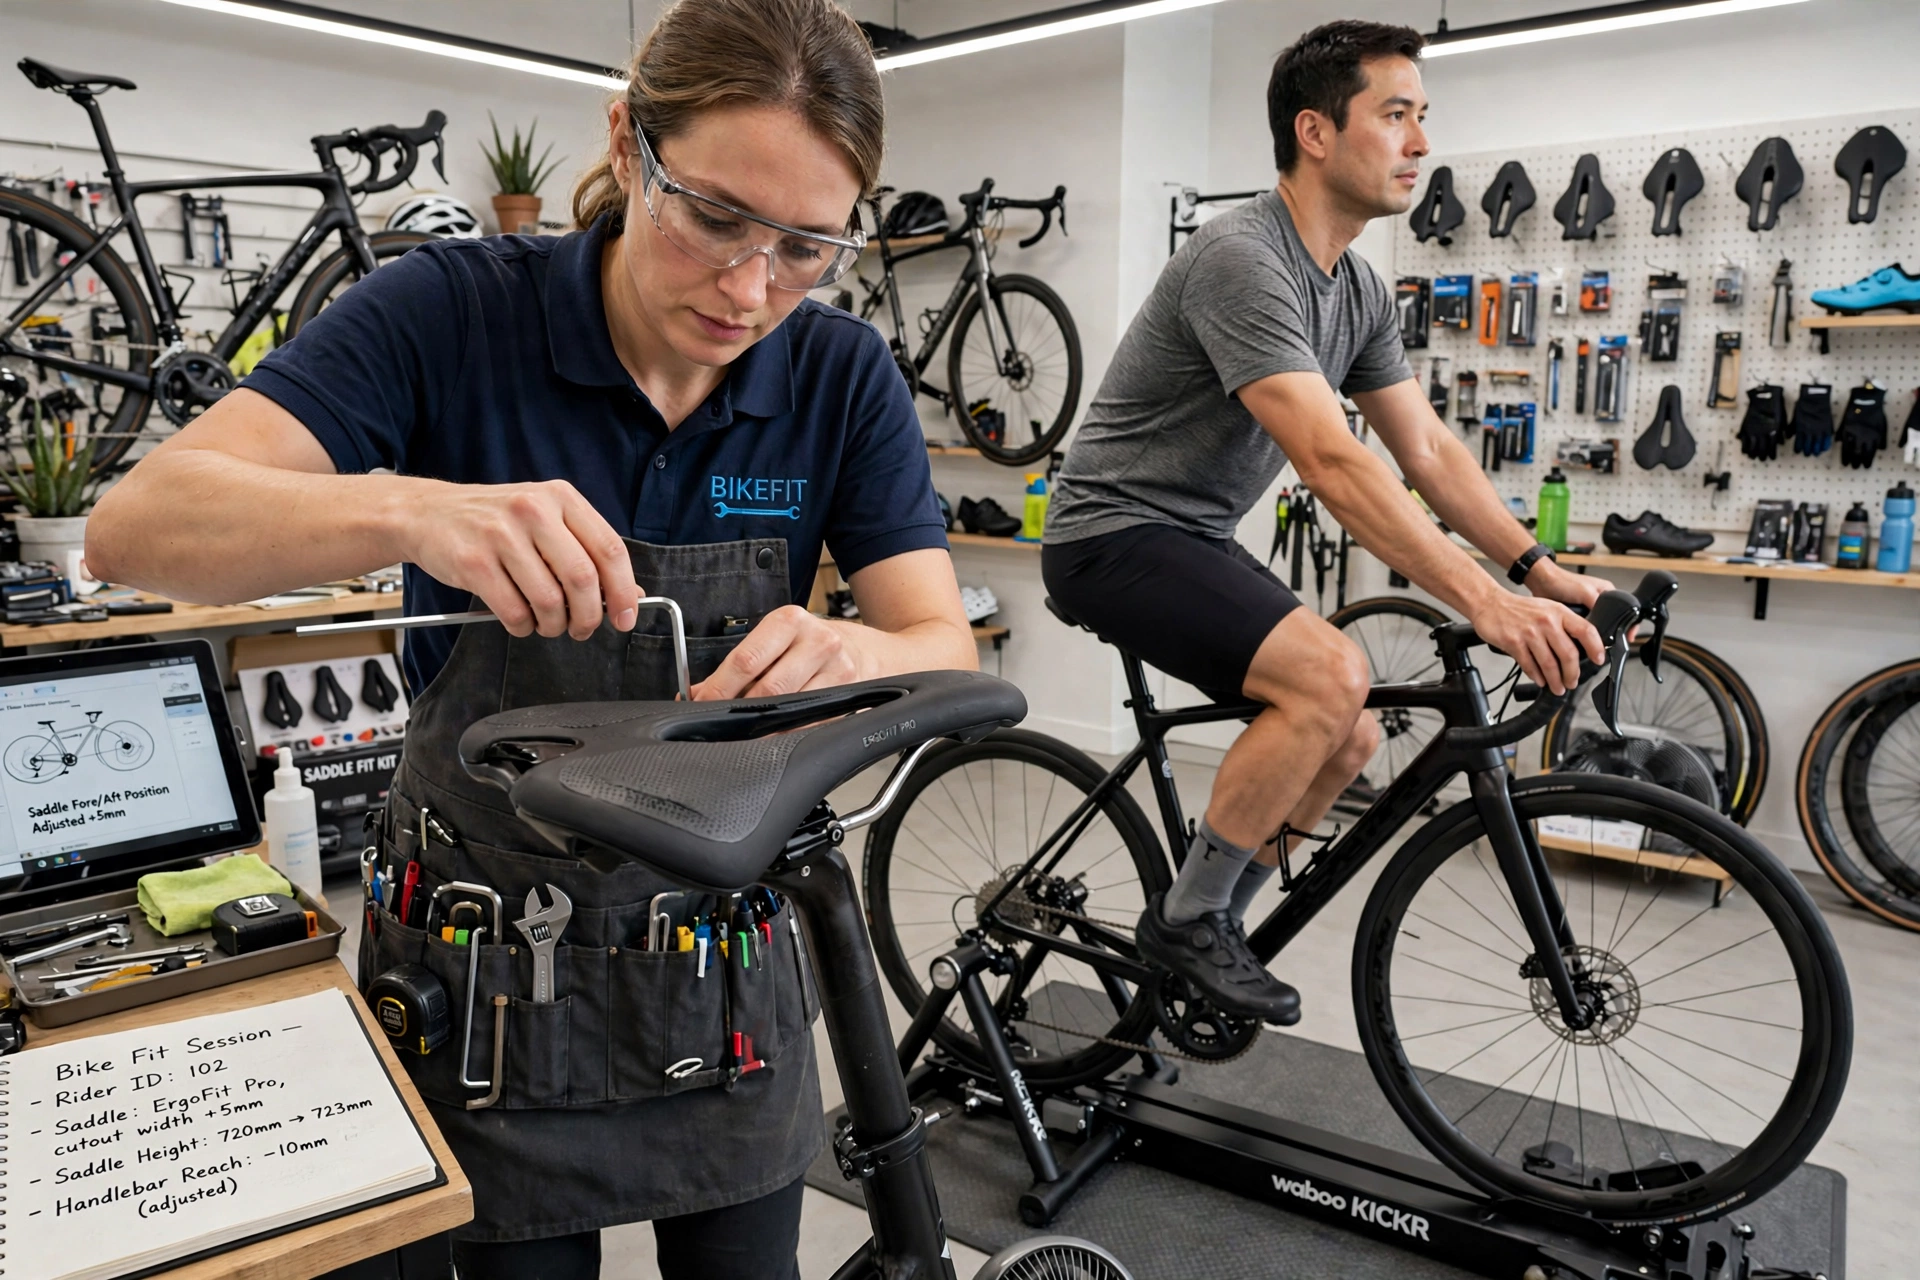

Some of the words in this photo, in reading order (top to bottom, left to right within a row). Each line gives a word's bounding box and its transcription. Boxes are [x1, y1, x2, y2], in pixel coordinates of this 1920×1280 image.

[711, 475, 807, 502] BIKEFIT
[304, 762, 354, 783] SADDLE
[357, 758, 376, 773] FIT
[377, 754, 397, 770] KIT
[28, 801, 69, 818] Saddle
[72, 791, 121, 810] Fore/Aft
[124, 785, 170, 801] Position
[32, 814, 86, 834] Adjusted
[88, 808, 126, 821] +5mm
[56, 1060, 115, 1081] Bike
[131, 1045, 169, 1065] Fit
[187, 1029, 272, 1054] Session
[55, 1108, 138, 1136] Saddle:
[153, 1085, 232, 1113] ErgoFit
[245, 1078, 285, 1092] Pro,
[56, 1086, 117, 1107] Rider
[130, 1072, 174, 1091] ID:
[190, 1059, 228, 1077] 102
[54, 1129, 124, 1156] cutout
[137, 1112, 193, 1136] width
[204, 1100, 264, 1118] +5mm
[55, 1157, 125, 1185] Saddle
[137, 1137, 208, 1164] Height:
[217, 1121, 283, 1143] 720mm
[311, 1097, 373, 1119] 723mm
[56, 1178, 169, 1217] Handlebar
[181, 1155, 253, 1184] Reach:
[263, 1136, 329, 1157] -10mm
[138, 1176, 238, 1218] (adjusted)
[1271, 1174, 1347, 1211] waboo
[1350, 1195, 1430, 1242] KICKR
